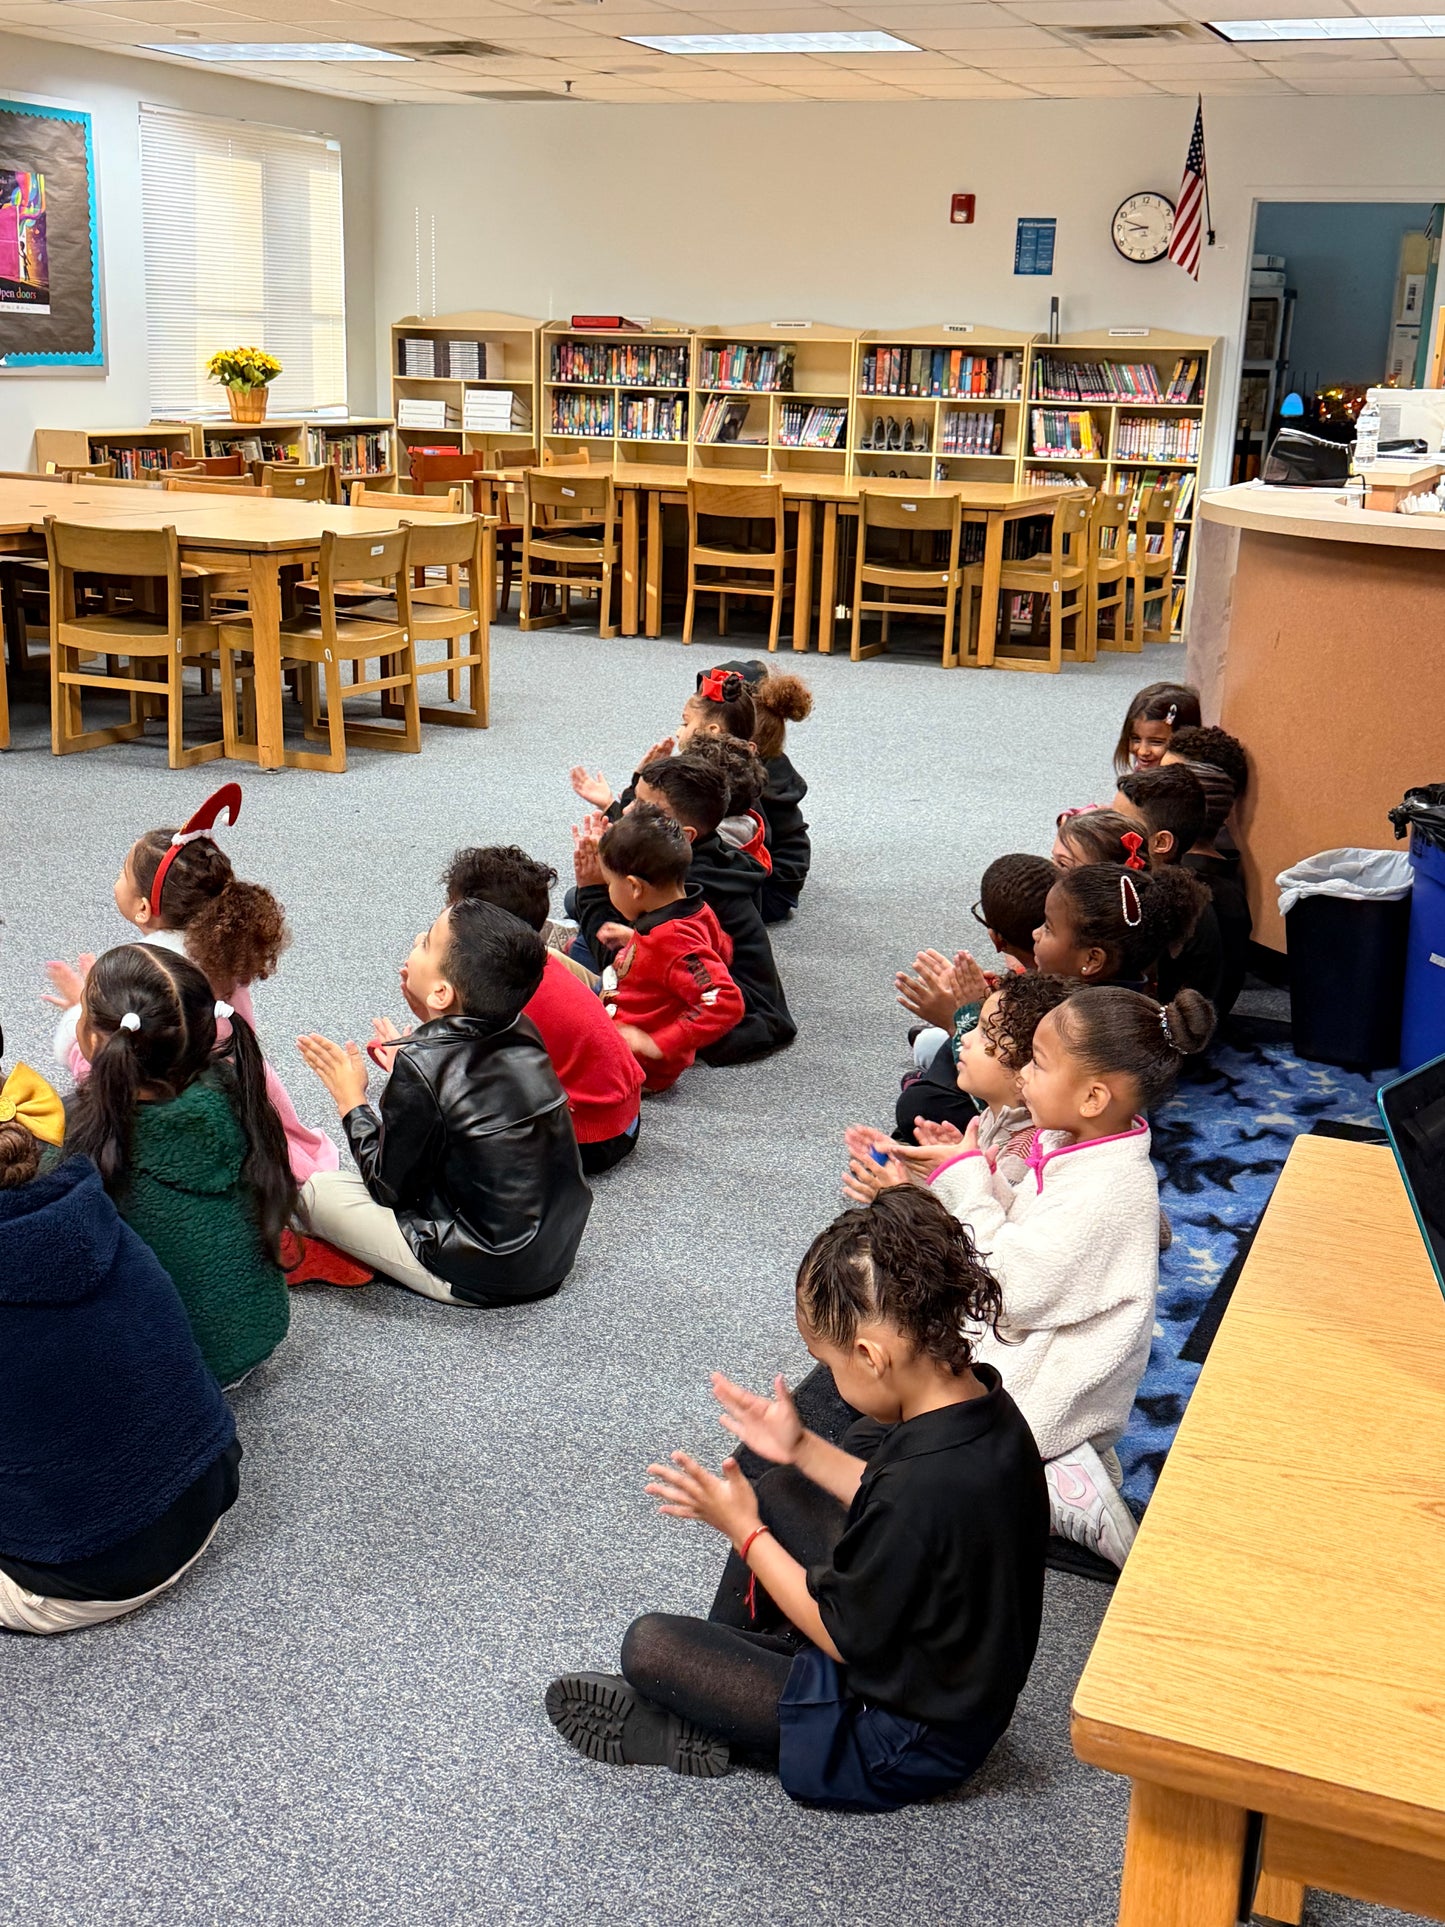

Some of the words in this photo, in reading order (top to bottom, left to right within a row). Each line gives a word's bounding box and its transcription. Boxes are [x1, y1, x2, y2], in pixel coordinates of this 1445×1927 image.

[1161, 236, 1168, 244] 4
[1140, 250, 1146, 259] 6
[1152, 246, 1158, 255] 5
[0, 288, 15, 301] pen
[16, 286, 37, 299] doors
